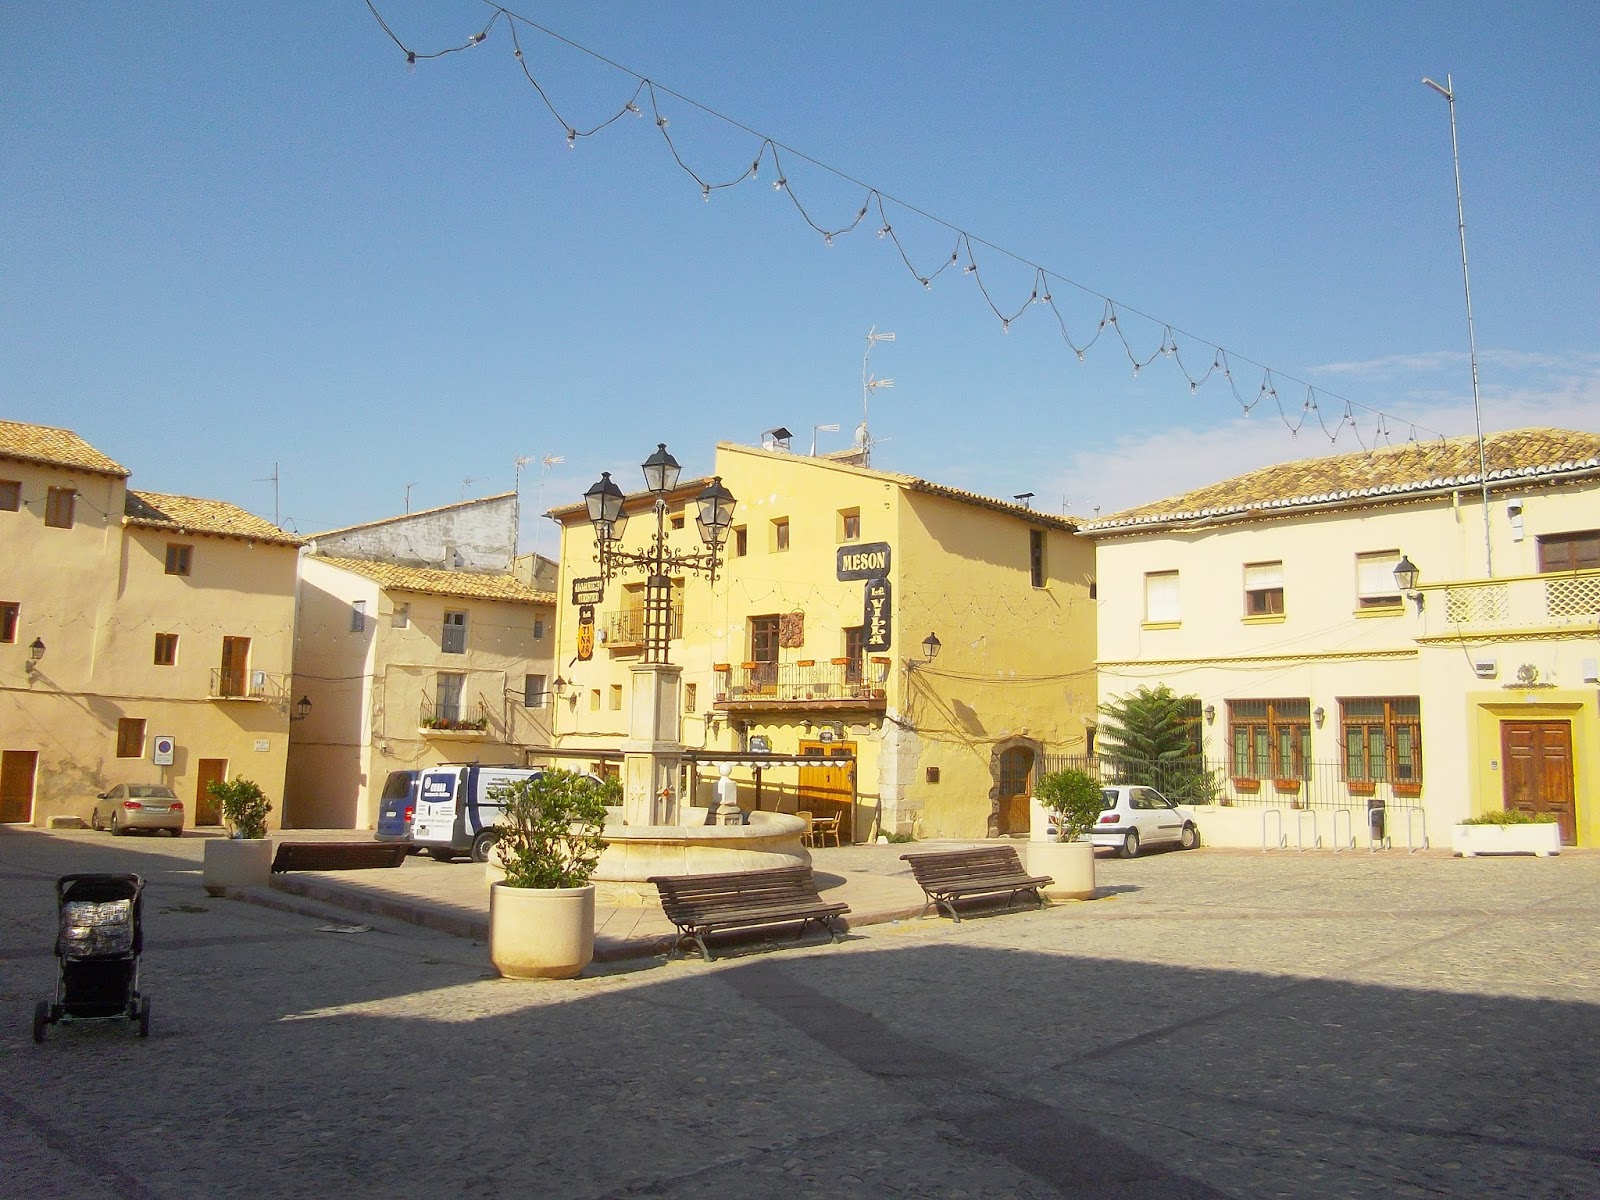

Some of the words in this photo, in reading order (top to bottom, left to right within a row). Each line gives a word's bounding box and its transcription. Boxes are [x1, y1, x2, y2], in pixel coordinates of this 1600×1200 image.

[842, 552, 885, 571] MESON
[871, 587, 885, 596] LA
[869, 598, 886, 644] VILLA
